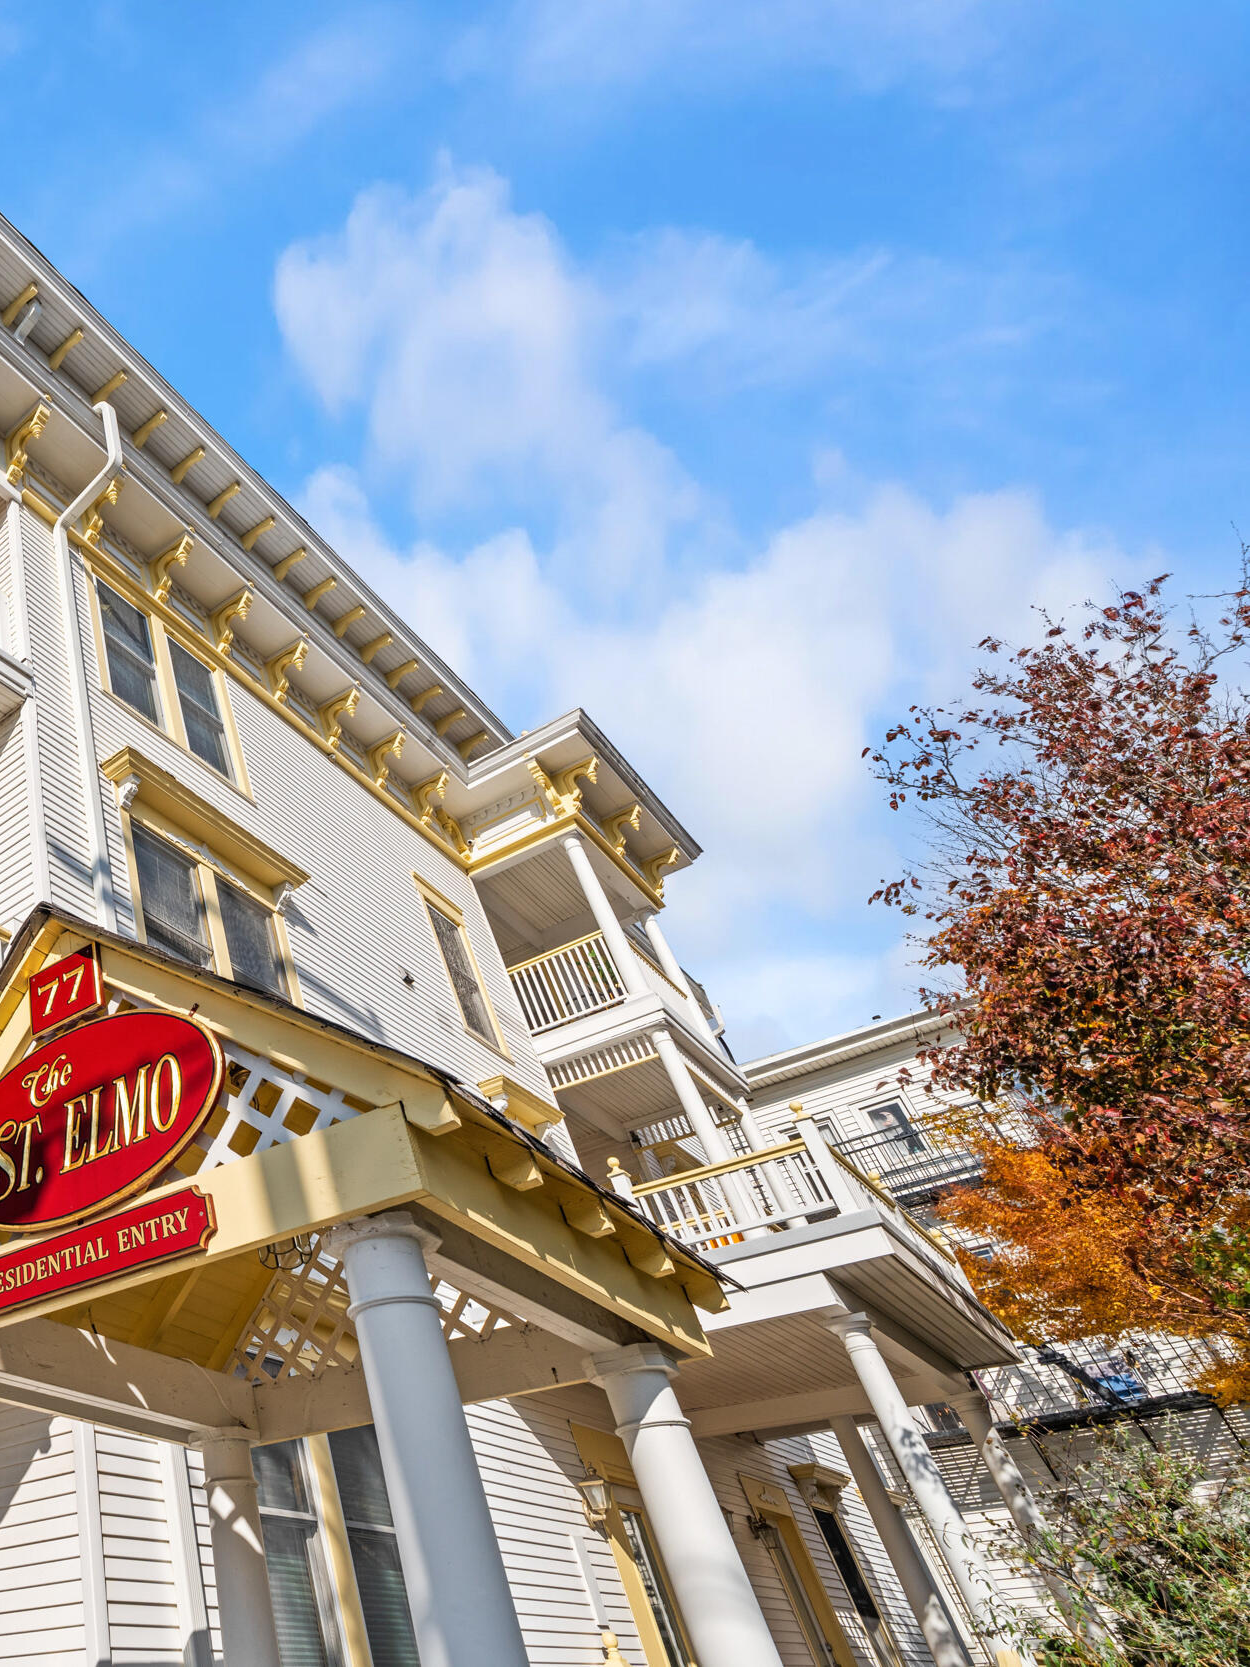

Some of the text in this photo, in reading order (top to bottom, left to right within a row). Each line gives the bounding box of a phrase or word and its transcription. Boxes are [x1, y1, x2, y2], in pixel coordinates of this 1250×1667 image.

[38, 964, 85, 1017] 77
[22, 1053, 73, 1108] The
[59, 1053, 182, 1175] ELMO
[116, 1207, 190, 1253] ENTRY
